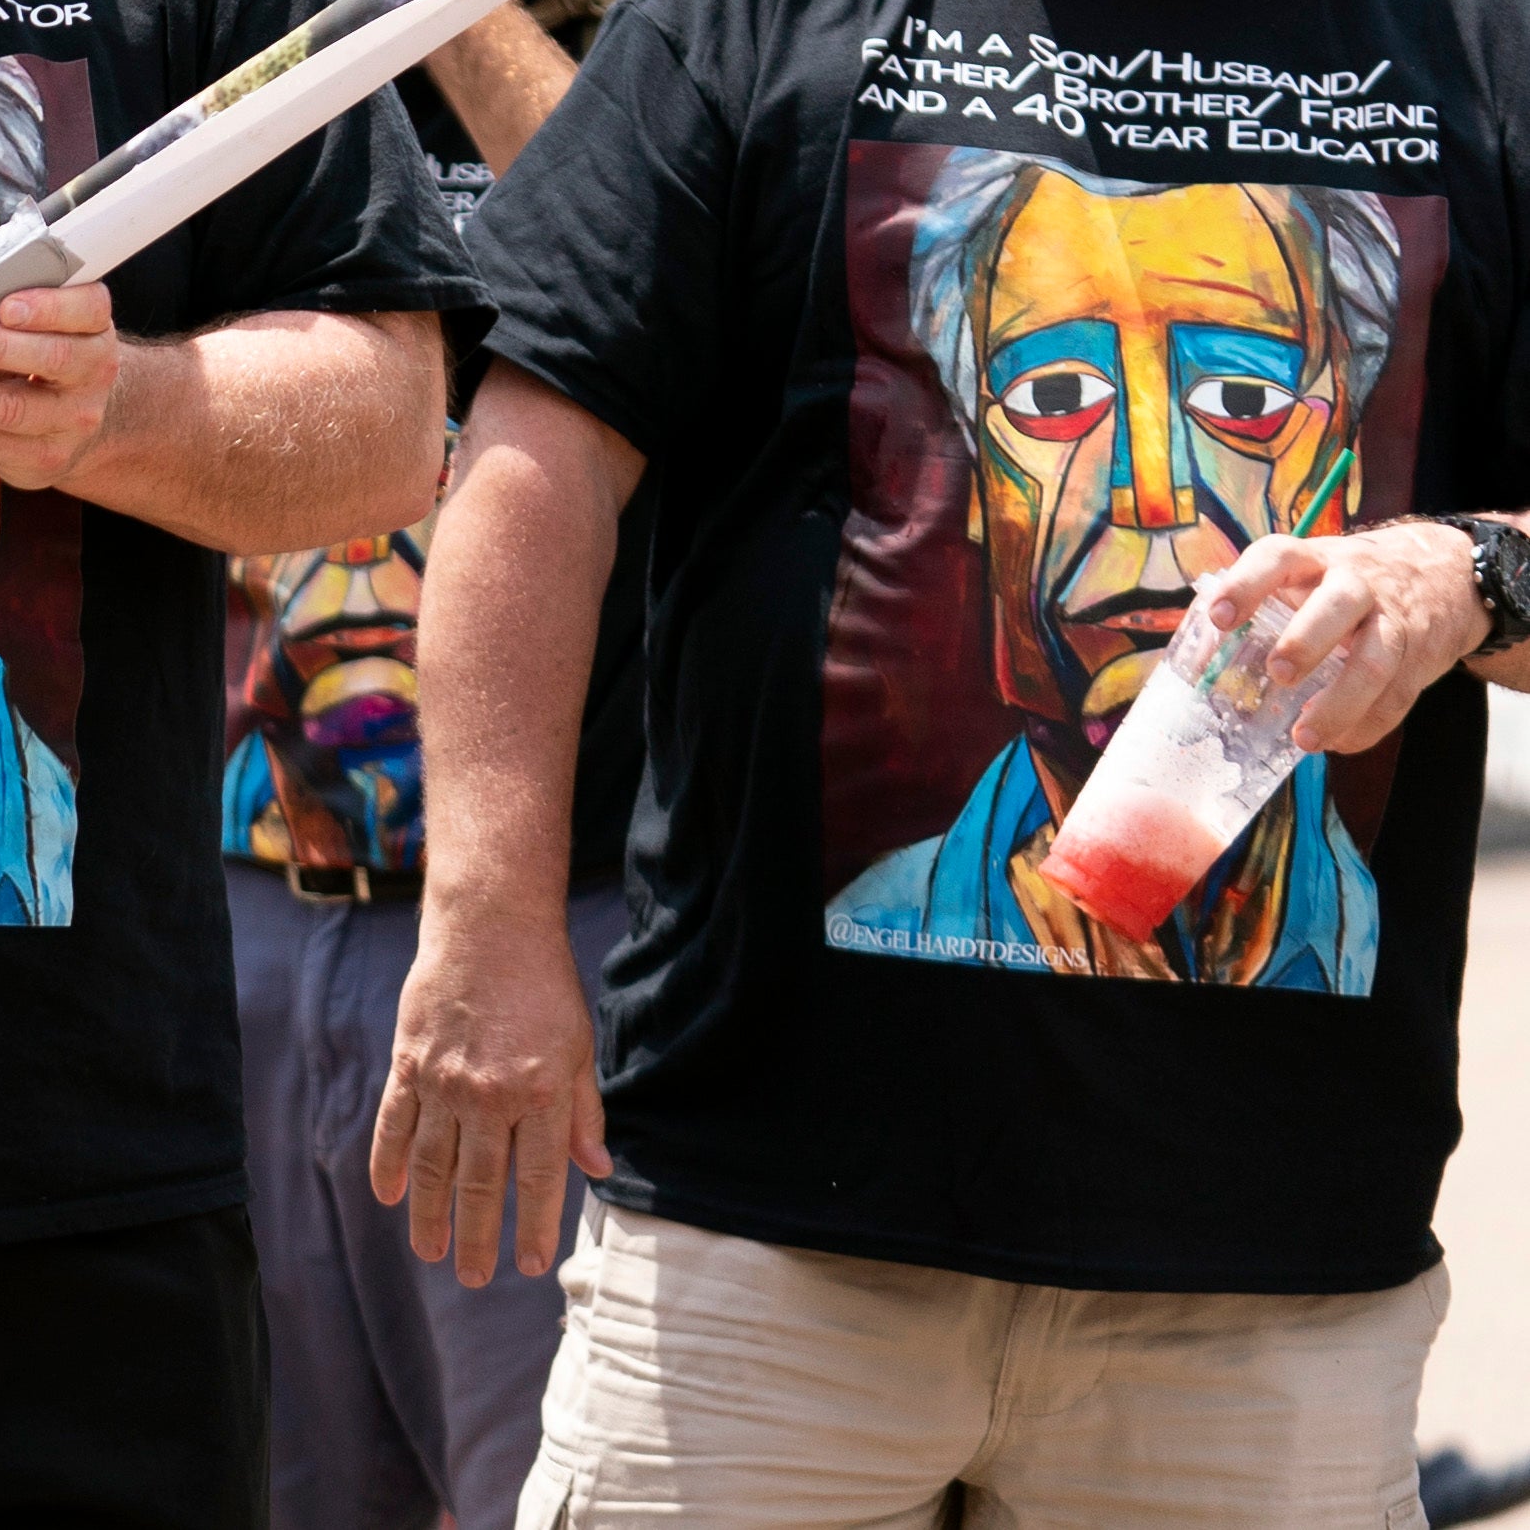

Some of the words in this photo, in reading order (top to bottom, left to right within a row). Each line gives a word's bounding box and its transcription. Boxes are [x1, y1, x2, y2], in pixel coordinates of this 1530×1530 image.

[902, 15, 964, 53] I'M
[978, 32, 1012, 58] A
[861, 38, 1039, 91] FATHER/
[1300, 98, 1438, 132] FRIEND
[858, 84, 948, 116] AND
[961, 95, 997, 122] A
[1012, 92, 1086, 138] 40
[1101, 121, 1209, 151] YEAR
[826, 913, 1088, 969] @ENGELHARDTDESIGNS
